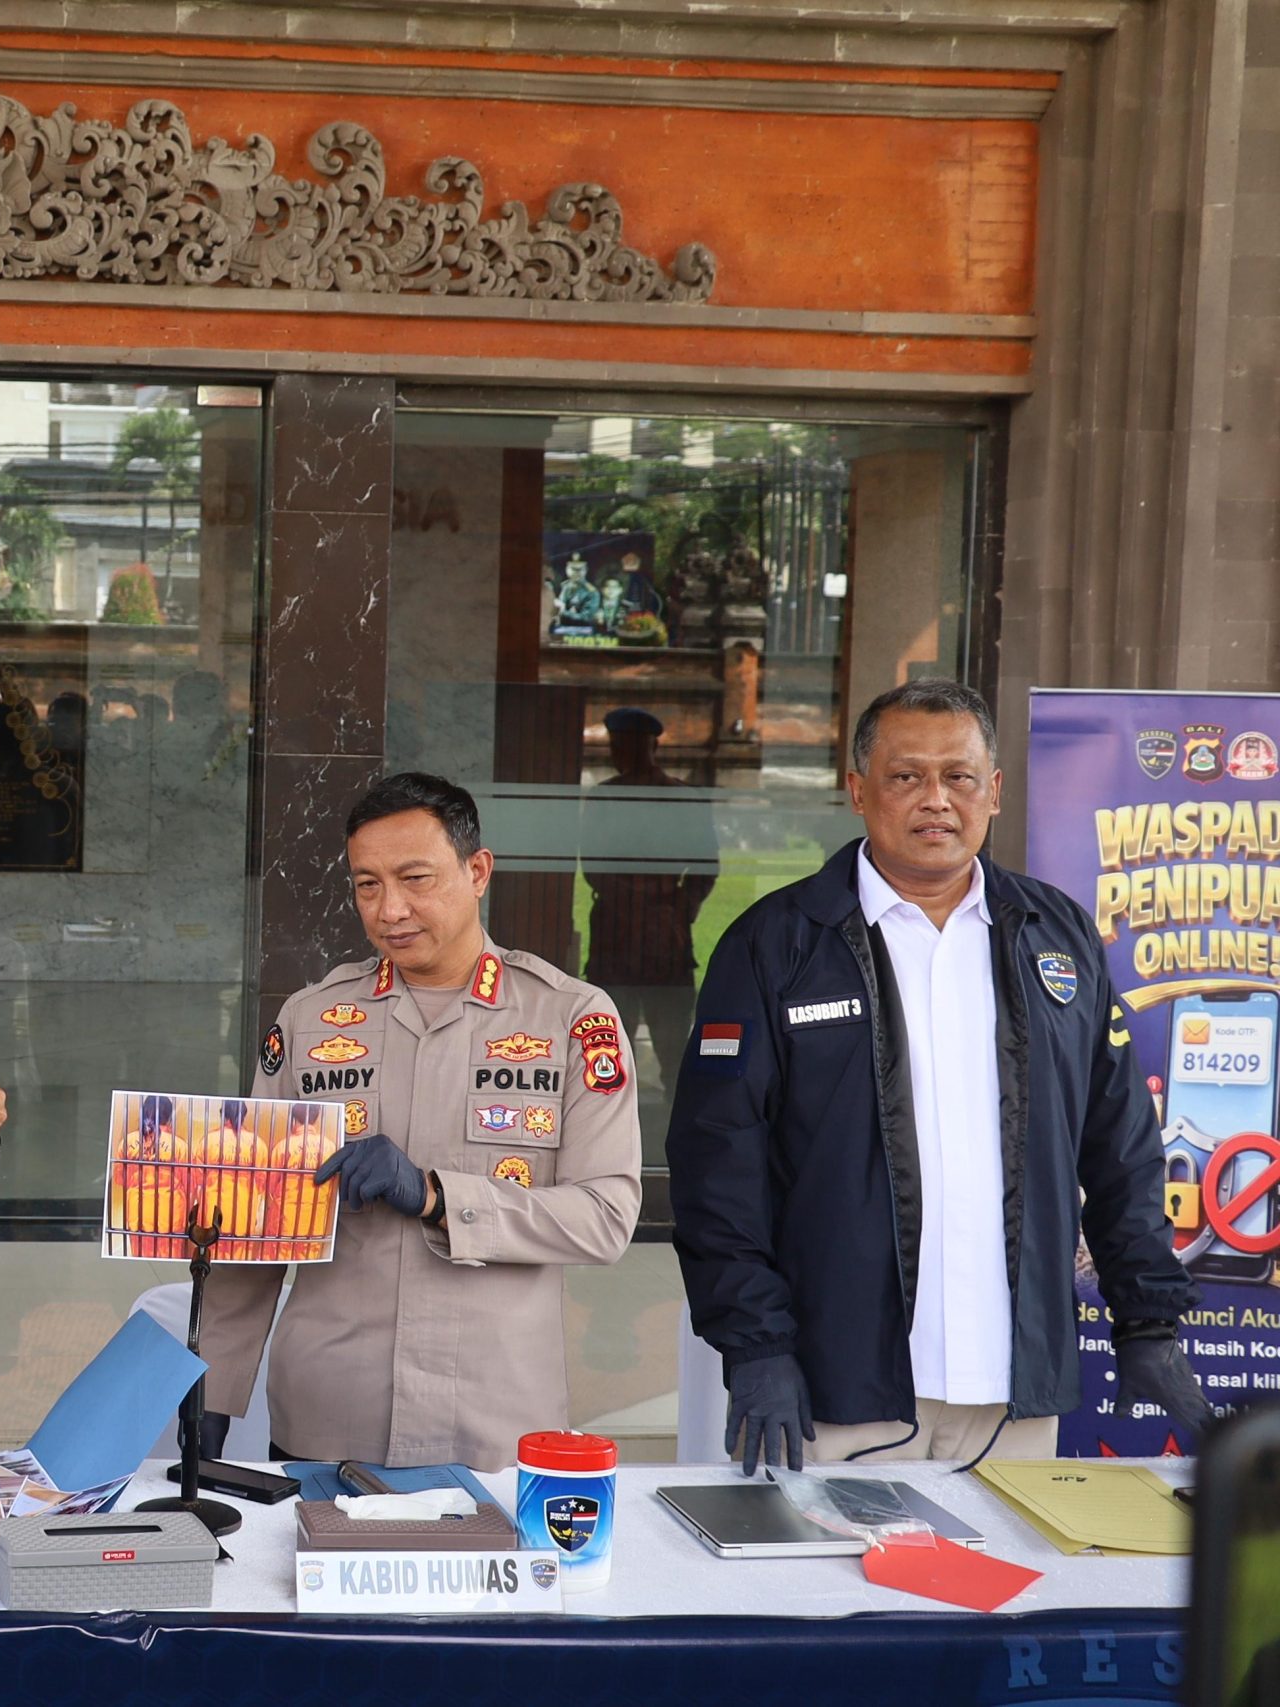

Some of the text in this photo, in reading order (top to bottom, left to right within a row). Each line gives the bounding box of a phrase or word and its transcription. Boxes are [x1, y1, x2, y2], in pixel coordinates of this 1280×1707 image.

[787, 998, 862, 1025] KASUBDIT 3
[574, 1016, 615, 1035] POLDA
[585, 1033, 616, 1045] BALI
[1183, 1052, 1261, 1073] 814209
[301, 1067, 375, 1095] SANDY
[476, 1067, 559, 1092] POLRI
[1194, 1339, 1245, 1357] kasih
[1207, 1373, 1248, 1388] asal
[340, 1558, 519, 1595] KABID HUMAS
